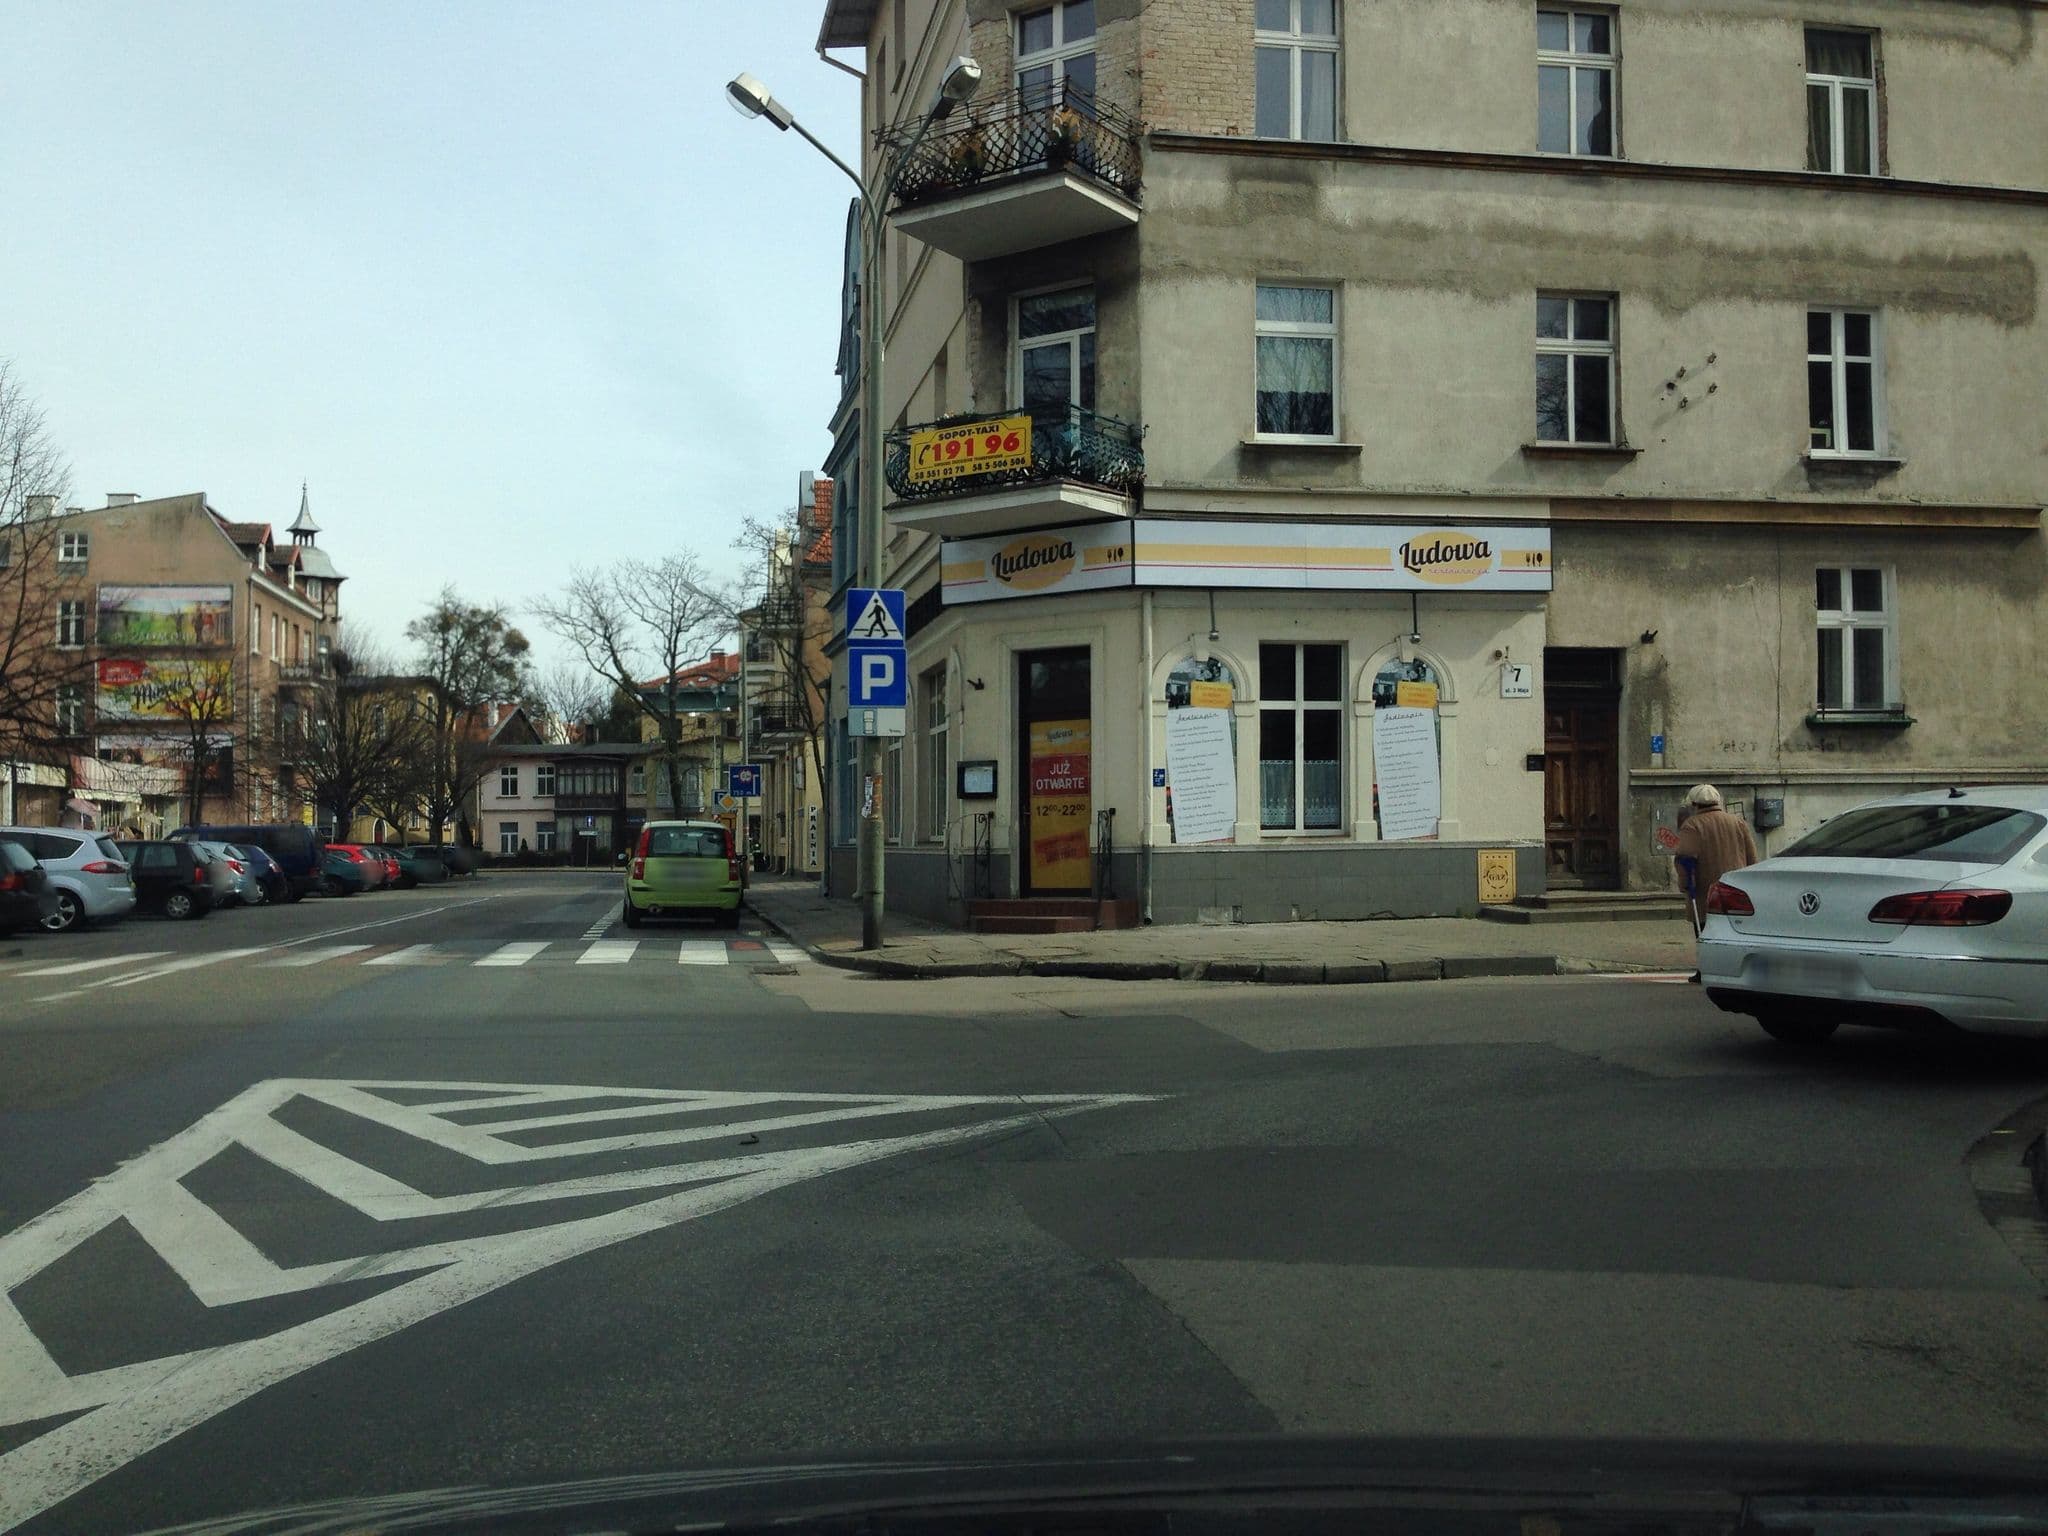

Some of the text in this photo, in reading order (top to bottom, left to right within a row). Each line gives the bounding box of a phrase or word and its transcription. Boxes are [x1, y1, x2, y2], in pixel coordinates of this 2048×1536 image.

[938, 424, 1000, 441] SOPOT-TAXI
[932, 437, 975, 462] 191
[985, 431, 1020, 454] 96
[985, 461, 991, 470] 5
[992, 458, 1008, 469] 506
[1010, 456, 1026, 466] 506
[991, 541, 1075, 582] Ludowa
[1398, 540, 1493, 573] Ludowa
[861, 654, 895, 700] P
[1513, 668, 1521, 682] 7
[1050, 760, 1071, 775] JUŻ
[1036, 777, 1085, 790] OTWARTE
[810, 806, 818, 867] PRALNIA
